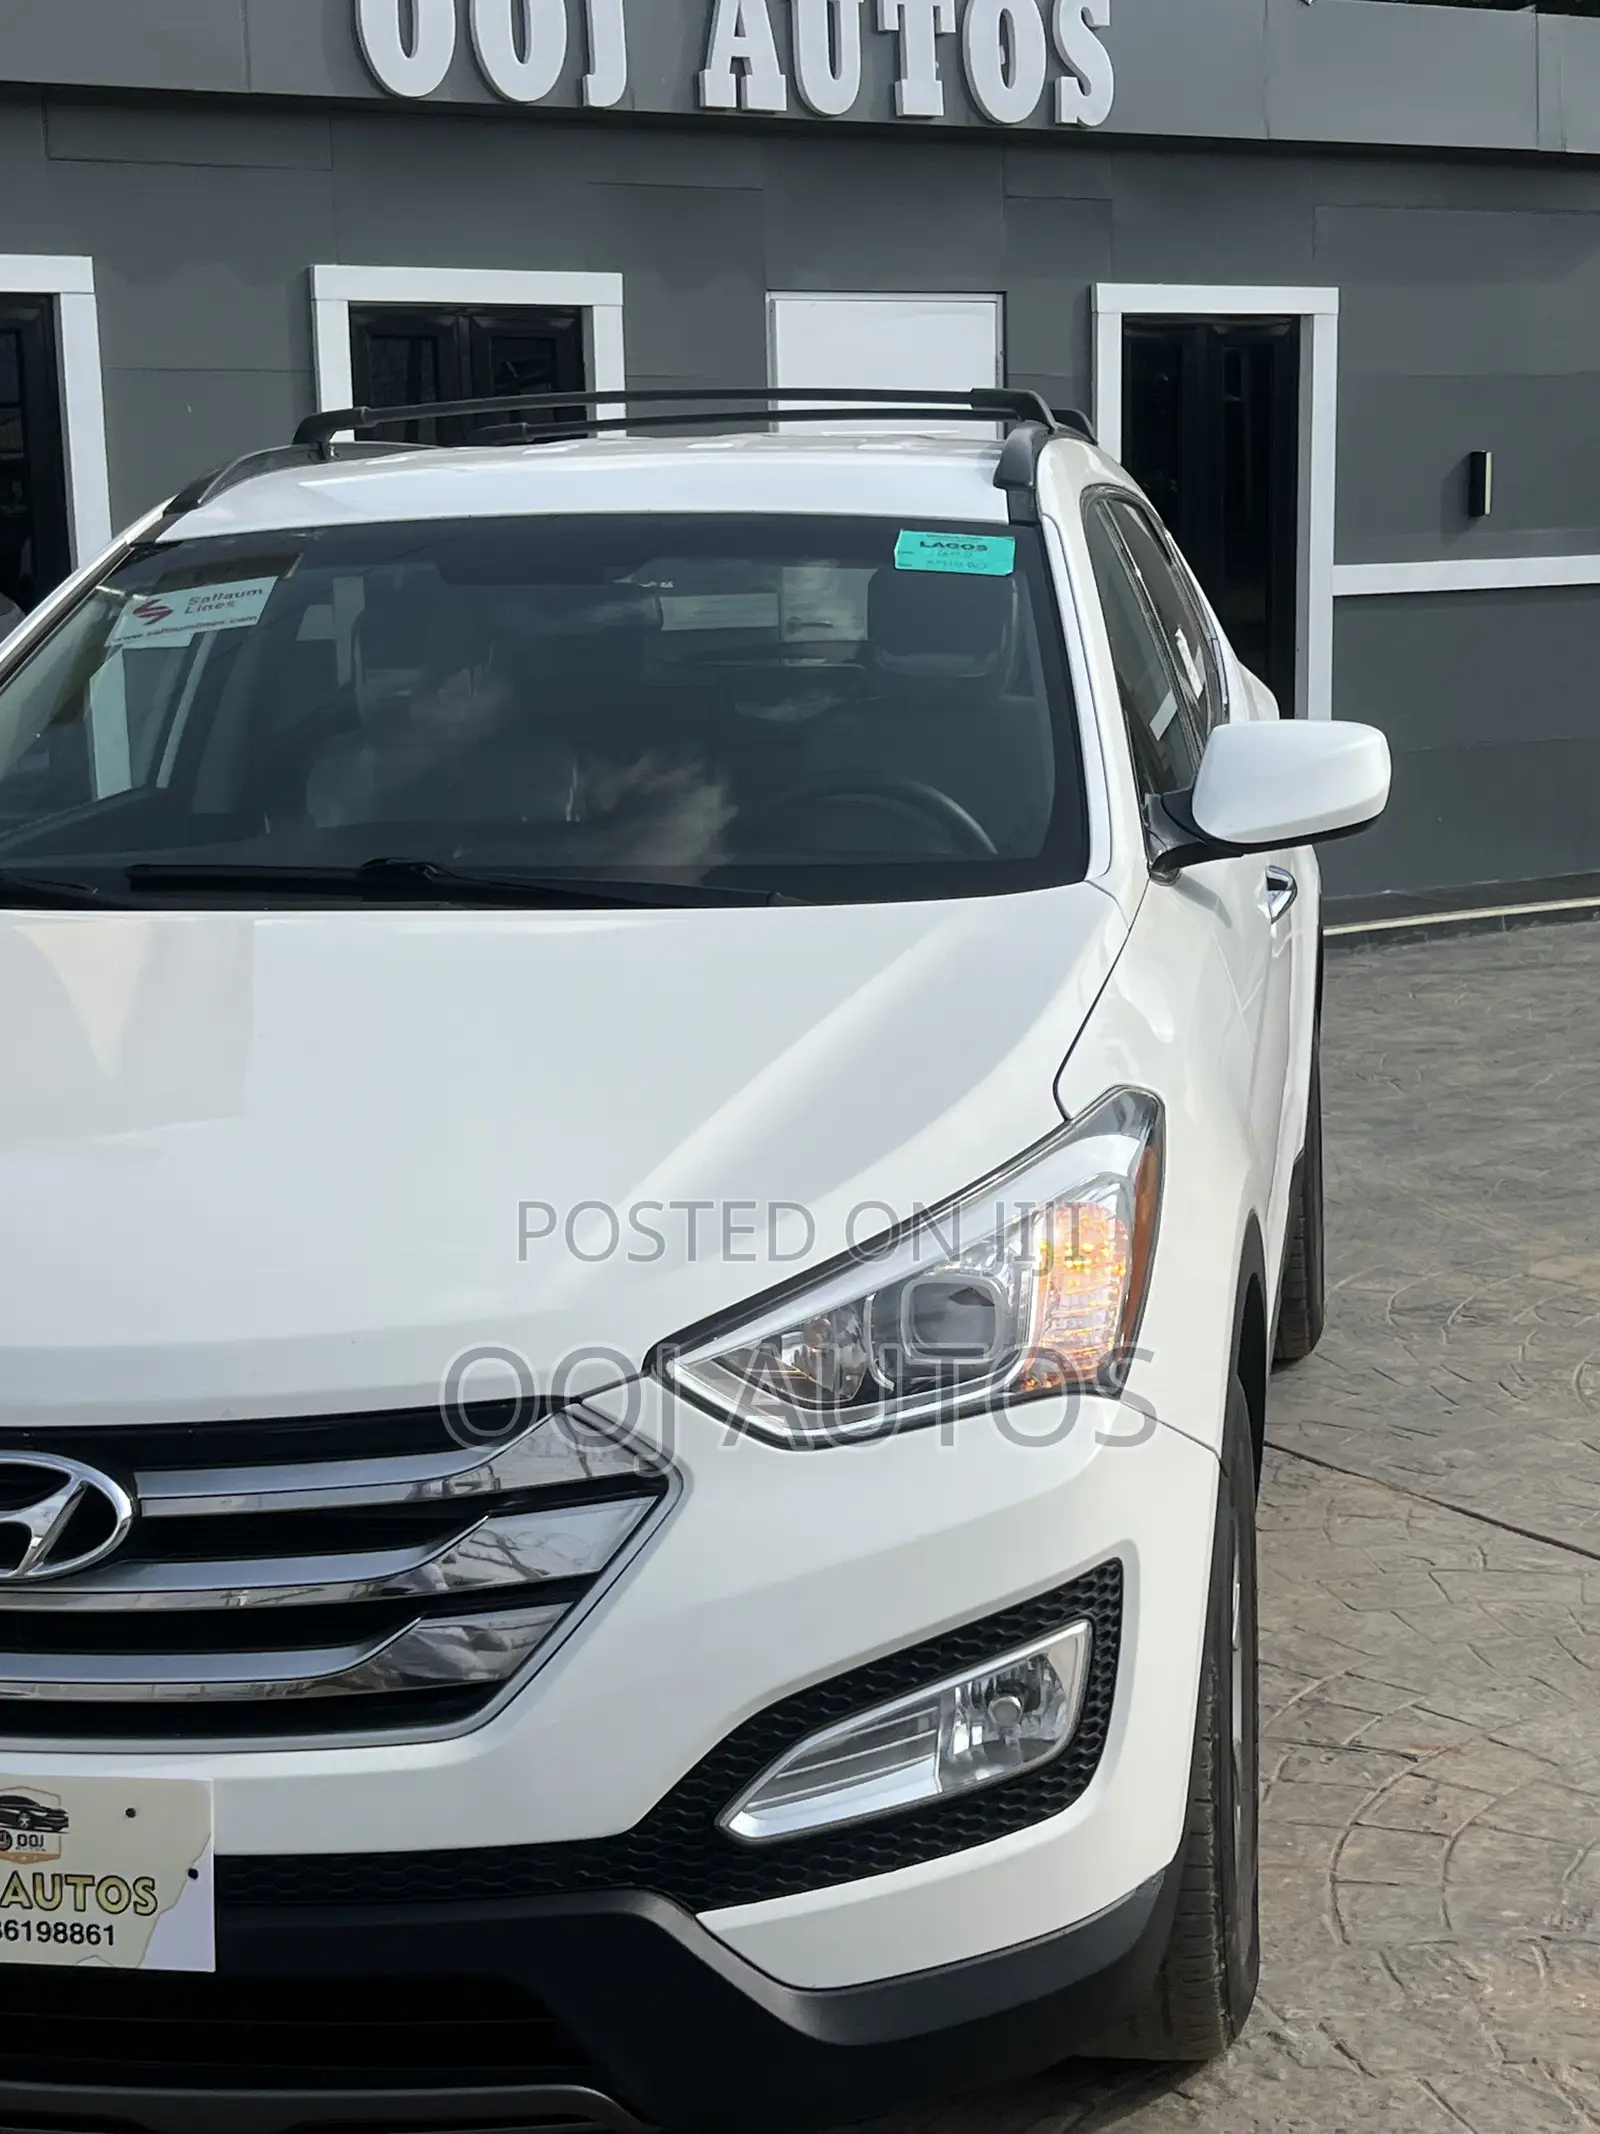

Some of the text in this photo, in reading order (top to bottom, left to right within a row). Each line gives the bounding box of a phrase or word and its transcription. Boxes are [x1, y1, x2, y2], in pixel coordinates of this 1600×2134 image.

[698, 0, 1115, 128] AUTOS
[919, 540, 989, 552] LAGOS
[184, 601, 237, 615] Lines
[188, 588, 263, 606] Sallaum
[0, 1870, 158, 1916] AUTOS
[0, 1919, 114, 1946] 6198861
